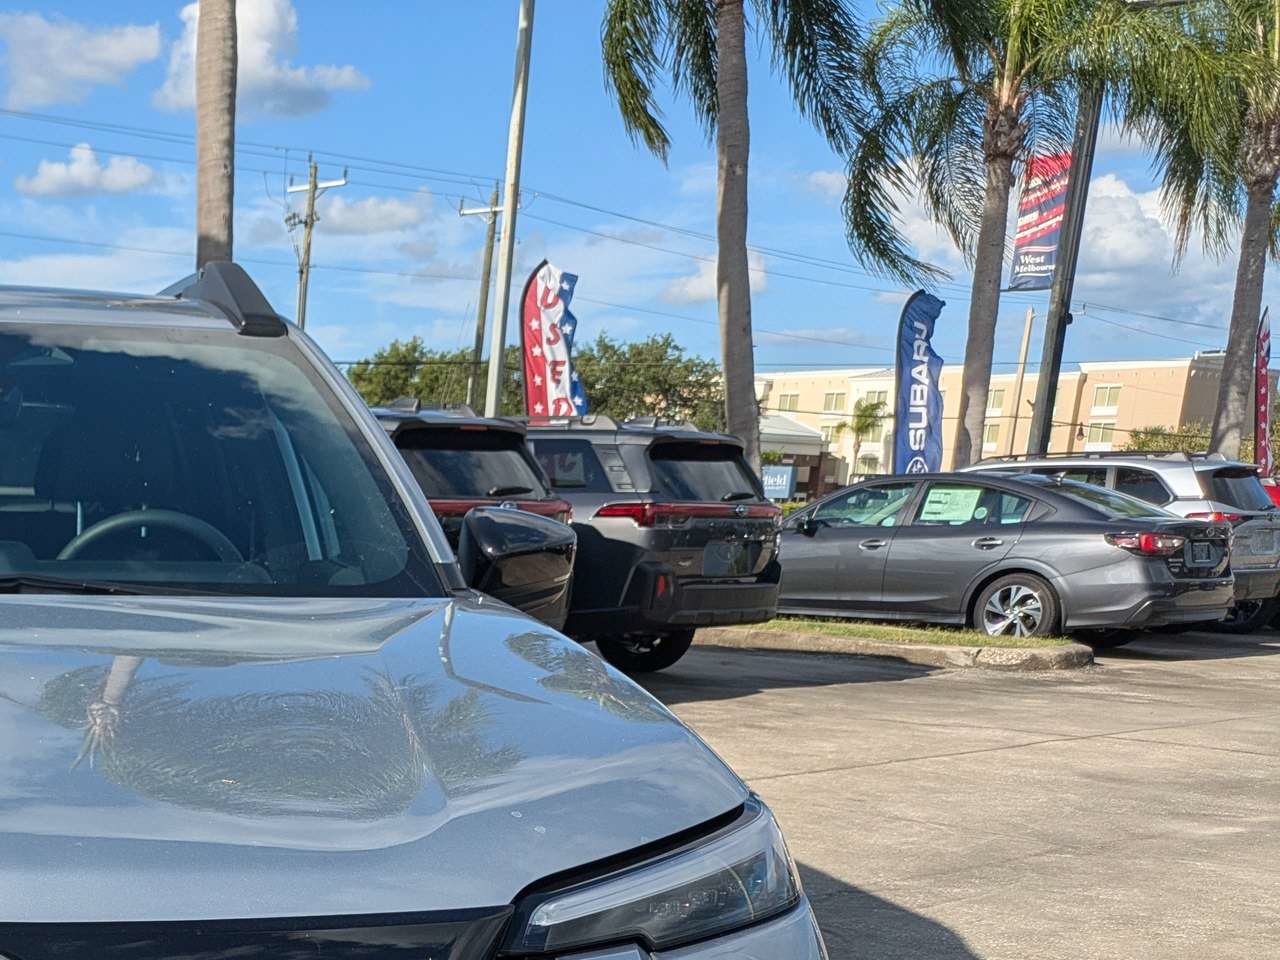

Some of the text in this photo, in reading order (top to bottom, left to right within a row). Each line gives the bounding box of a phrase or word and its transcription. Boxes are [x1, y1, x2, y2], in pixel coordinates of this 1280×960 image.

[1020, 255, 1045, 264] West
[541, 286, 574, 416] USED
[908, 321, 928, 451] SUBARU
